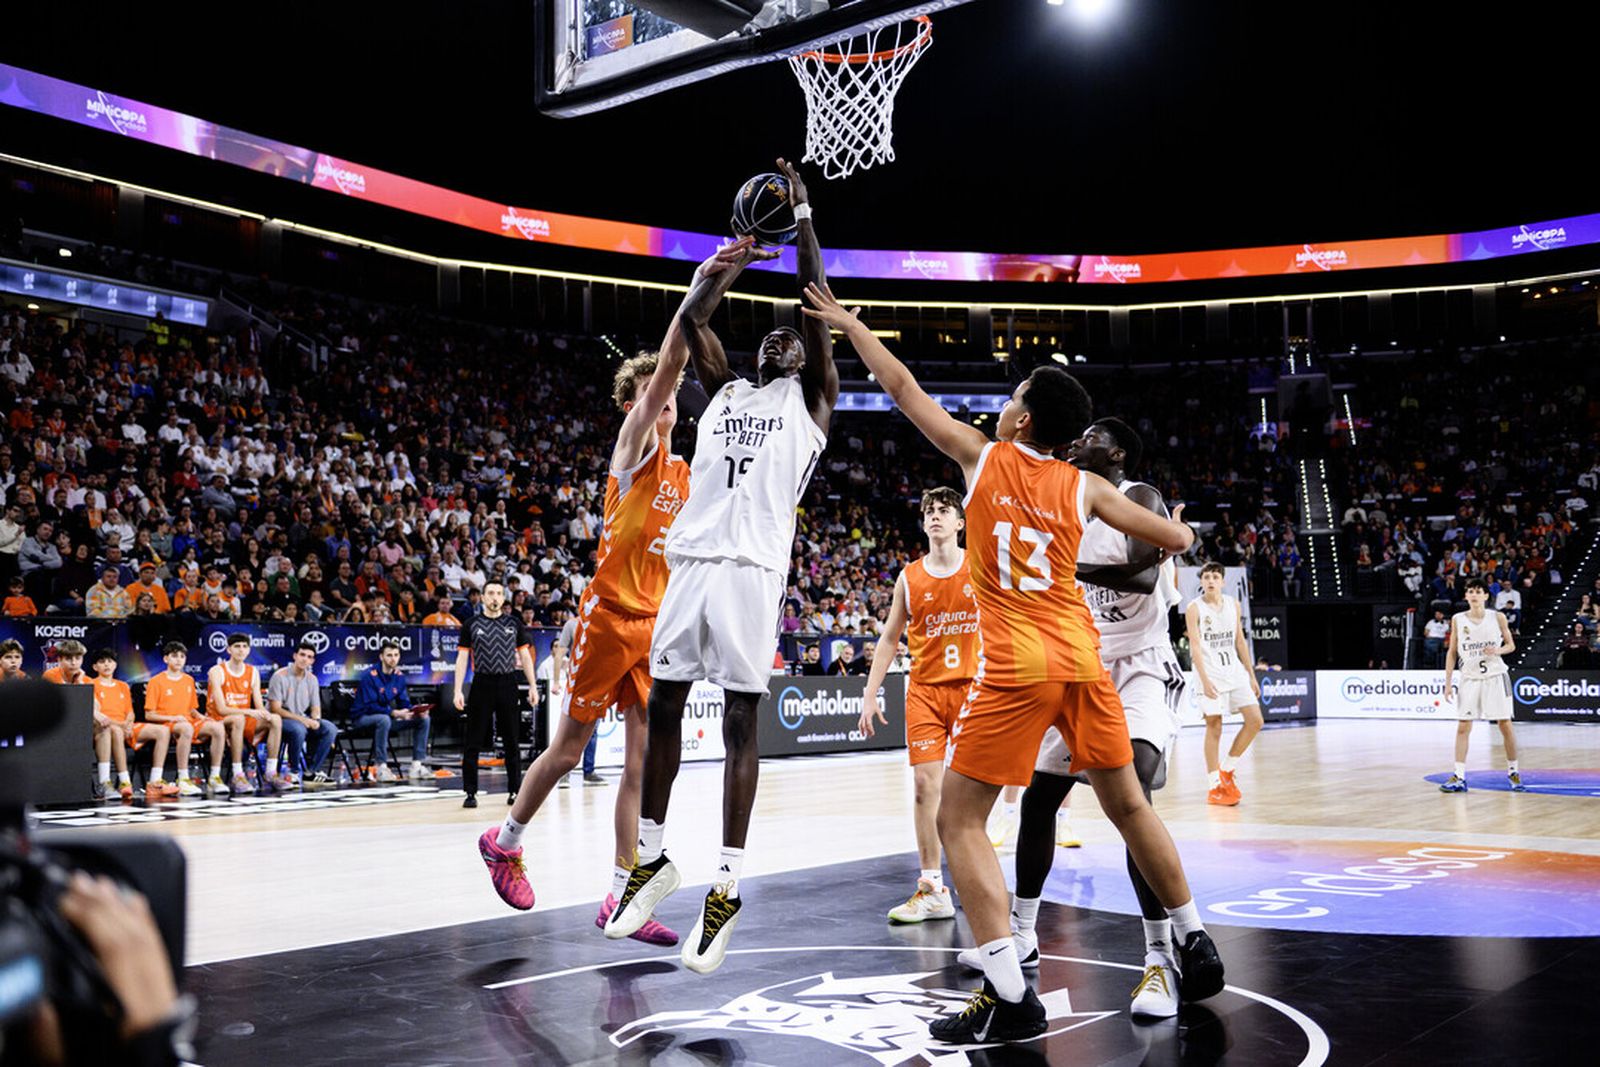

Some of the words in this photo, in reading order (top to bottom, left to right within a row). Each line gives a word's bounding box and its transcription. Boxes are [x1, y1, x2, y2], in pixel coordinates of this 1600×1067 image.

[992, 521, 1055, 592] 13
[925, 611, 967, 626] Cultura
[926, 622, 978, 638] Esfuerzo
[1250, 629, 1280, 639] ALIDA
[944, 644, 960, 669] 8
[1218, 651, 1231, 666] 11
[1478, 660, 1488, 674] 5
[784, 690, 886, 716] mediolanm
[1206, 847, 1514, 920] endesa
